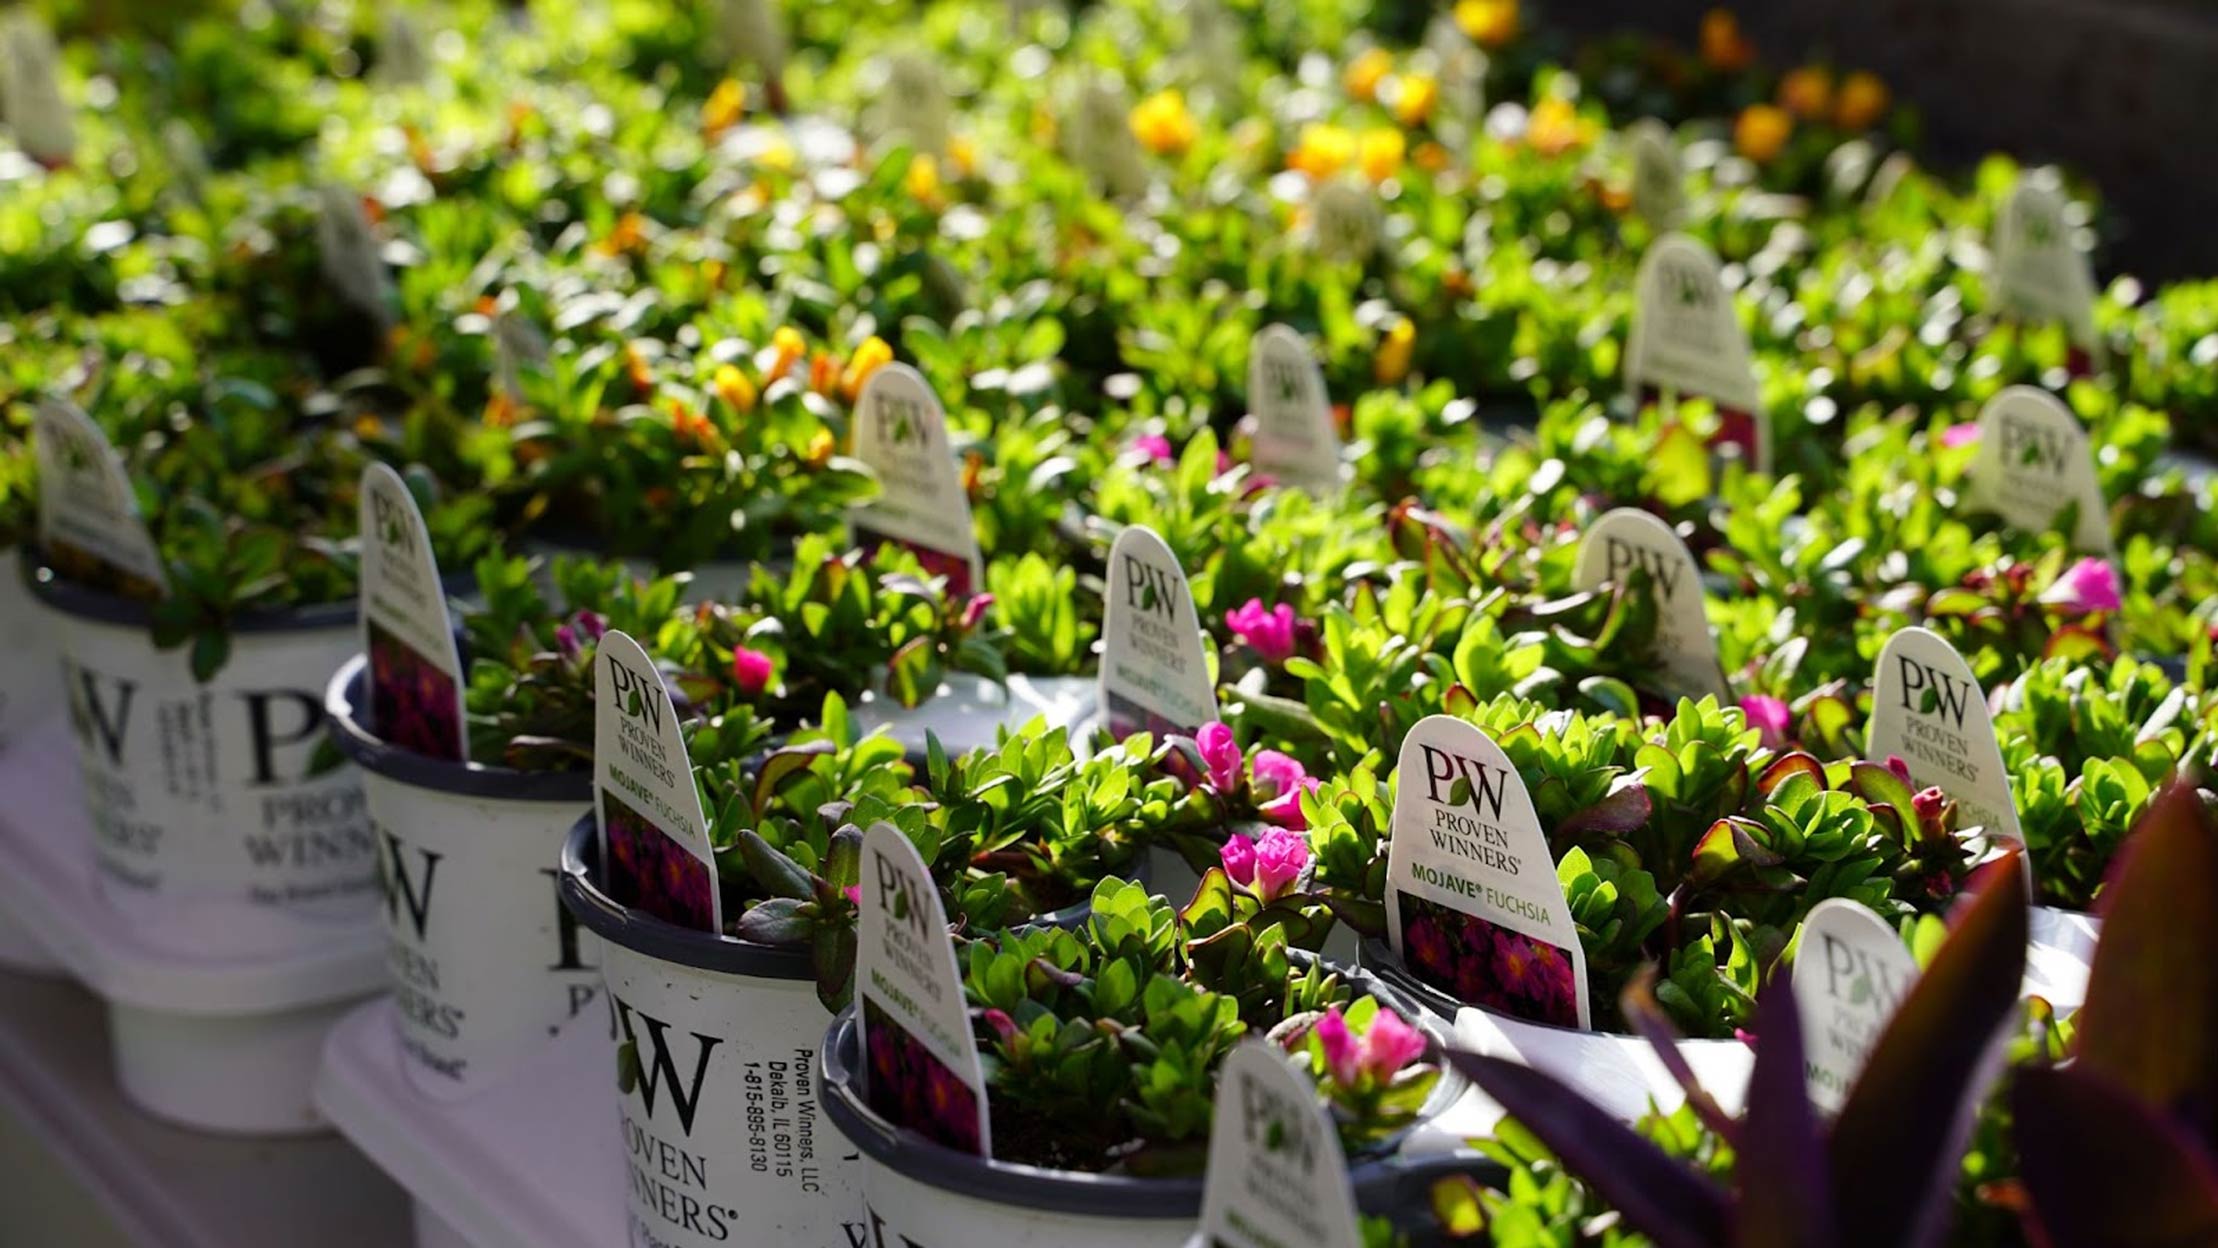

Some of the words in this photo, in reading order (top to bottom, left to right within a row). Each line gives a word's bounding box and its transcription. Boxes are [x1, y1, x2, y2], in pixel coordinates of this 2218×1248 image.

[1124, 554, 1178, 624] PW
[607, 653, 662, 736] PW
[1897, 655, 1970, 732] PW
[620, 716, 667, 762] PROVEN
[1906, 716, 1969, 758] PROVEN
[1419, 743, 1508, 822] PW
[654, 796, 696, 839] FUCHSIA
[1435, 808, 1509, 849] PROVEN
[874, 848, 930, 943] PW
[1487, 888, 1551, 927] FUCHSIA
[794, 1048, 814, 1096] Proven
[744, 1062, 768, 1172] 1-815-895-8130
[773, 1118, 790, 1130] IL
[797, 1100, 817, 1162] Winners,
[774, 1133, 793, 1177] 60115
[801, 1167, 820, 1193] LLC
